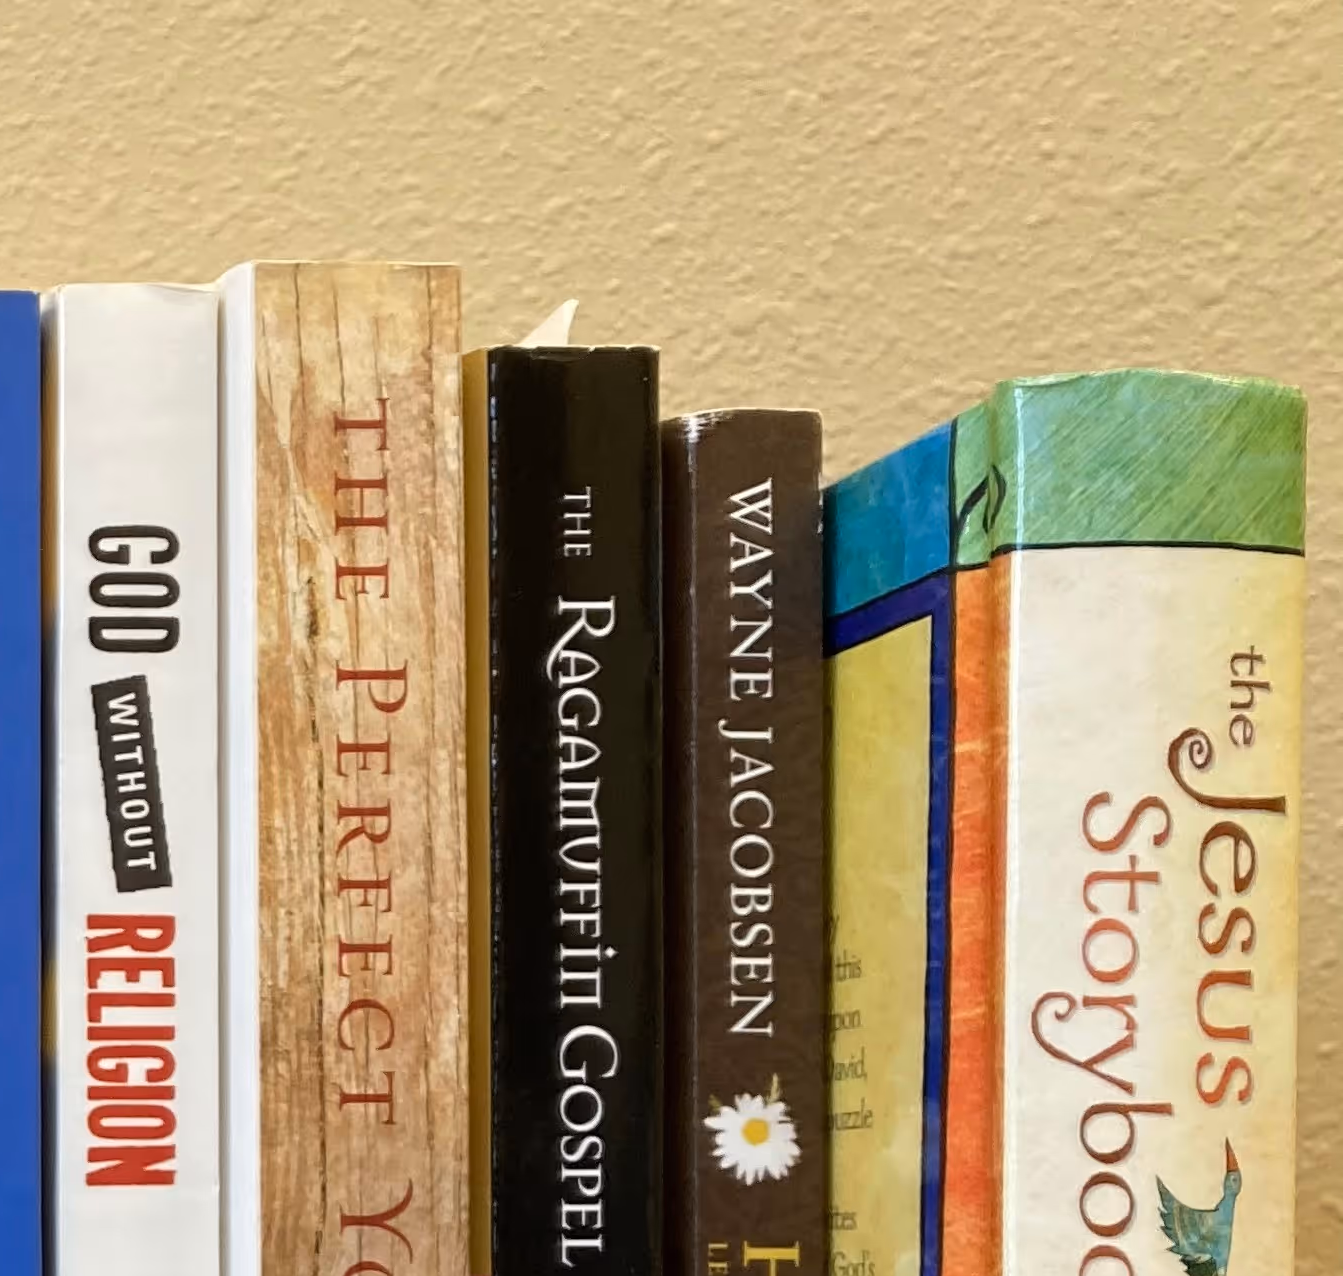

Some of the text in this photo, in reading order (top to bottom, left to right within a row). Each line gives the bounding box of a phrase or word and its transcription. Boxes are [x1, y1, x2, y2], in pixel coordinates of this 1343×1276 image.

[334, 397, 392, 602] THE
[559, 485, 592, 559] THE
[85, 523, 179, 1187] GOD WITHOUT RELIGION
[334, 660, 410, 1125] PERFECT
[718, 477, 775, 1038] WAYNE JACOBSEN
[1166, 645, 1288, 1108] the Jesus
[559, 1023, 619, 1269] GOSPEL
